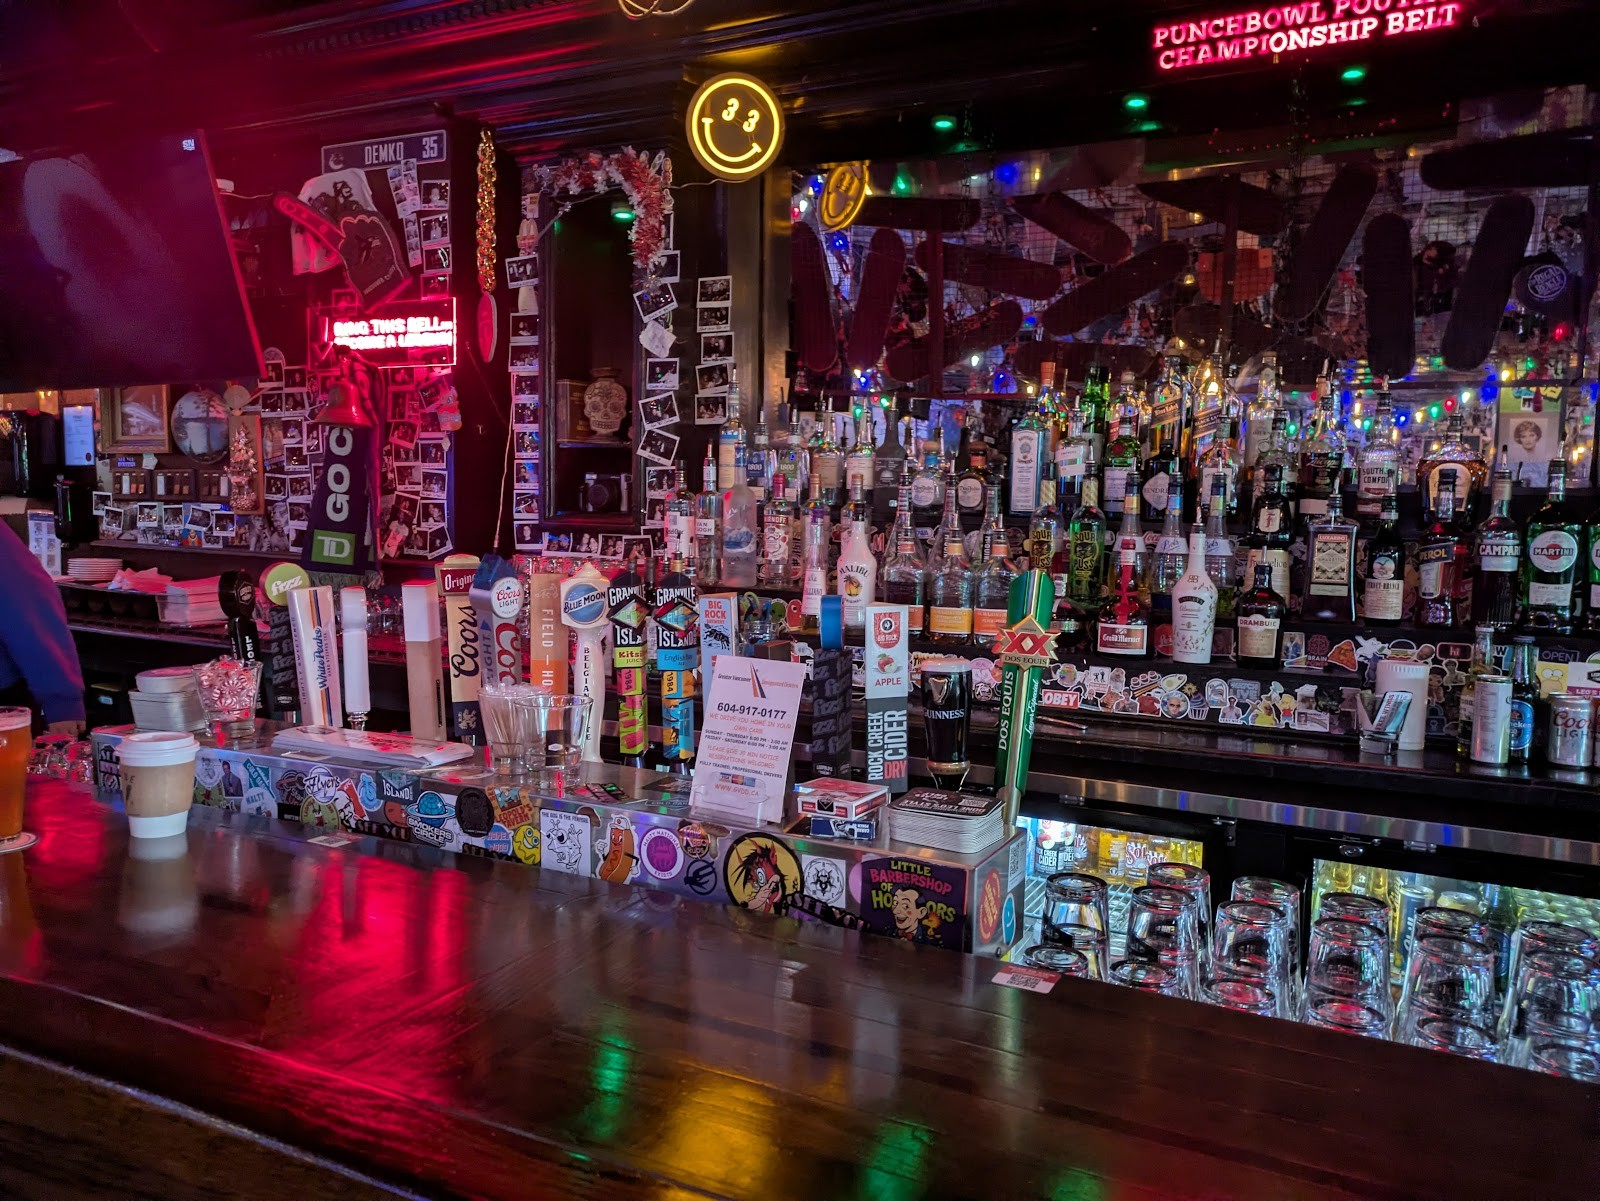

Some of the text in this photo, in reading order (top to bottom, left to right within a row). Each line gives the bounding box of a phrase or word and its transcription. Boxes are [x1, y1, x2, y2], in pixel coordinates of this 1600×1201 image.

[1153, 2, 1326, 48] PUNCHBOWL
[1158, 4, 1460, 69] CHAMPIONSHIP BELT
[364, 136, 439, 165] DEMKO 35
[326, 463, 350, 523] GO
[1074, 531, 1096, 542] SOUR
[317, 536, 350, 558] TD
[1534, 548, 1573, 556] MARTINI
[1031, 556, 1051, 568] PUSS
[1074, 558, 1095, 571] PUSS
[838, 564, 871, 578] MALIBU
[496, 589, 521, 601] Coors
[498, 598, 519, 608] LIGHT
[563, 591, 606, 614] BLUE MOON
[609, 584, 646, 607] GRANVILLE
[656, 586, 696, 607] GRANVILLE
[704, 609, 727, 618] ROCK
[708, 601, 722, 610] BIG
[541, 609, 554, 648] FIELD
[1240, 619, 1277, 627] DRAMBUIE
[451, 605, 479, 679] Coors
[615, 626, 642, 645] ISLA
[657, 626, 694, 647] ISLAND
[1002, 631, 1052, 657] XX
[1449, 645, 1460, 656] hi
[312, 627, 328, 688] White Peaks
[1004, 655, 1047, 666] DOS EQUIS
[1542, 650, 1574, 662] OPEN
[624, 670, 633, 691] 1984
[666, 672, 674, 693] 1984
[874, 676, 902, 687] APPLE
[1044, 691, 1079, 707] OBEY
[717, 702, 787, 720] 604-917-0177
[998, 670, 1014, 751] DOS EQUIS
[737, 715, 749, 724] YOU
[750, 717, 767, 726] HOME
[767, 719, 775, 727] IN
[776, 720, 792, 729] YOUR
[1024, 712, 1034, 739] Lager
[724, 737, 747, 745] SATURDAY
[726, 732, 749, 740] THURSDAY
[1556, 728, 1590, 738] LIGH
[867, 711, 883, 781] ROCK CREEK
[747, 750, 759, 758] MIN
[759, 752, 780, 760] NOTICE
[731, 765, 763, 776] PROFESSIONAL
[763, 771, 783, 779] DRIVERS
[884, 760, 907, 779] DRY
[714, 783, 759, 796] WWW.GVDD.CA
[407, 817, 452, 840] SMOKERS
[502, 814, 530, 828] TAVERN
[357, 820, 410, 840] SEE YOU
[414, 828, 445, 843] CIRCLE
[656, 830, 681, 849] NATIONAL
[890, 860, 931, 876] LITTLE
[1038, 856, 1057, 866] CIDER
[869, 868, 952, 895] BARBERSHOP
[880, 882, 893, 893] OF
[871, 890, 957, 922] HOORS
